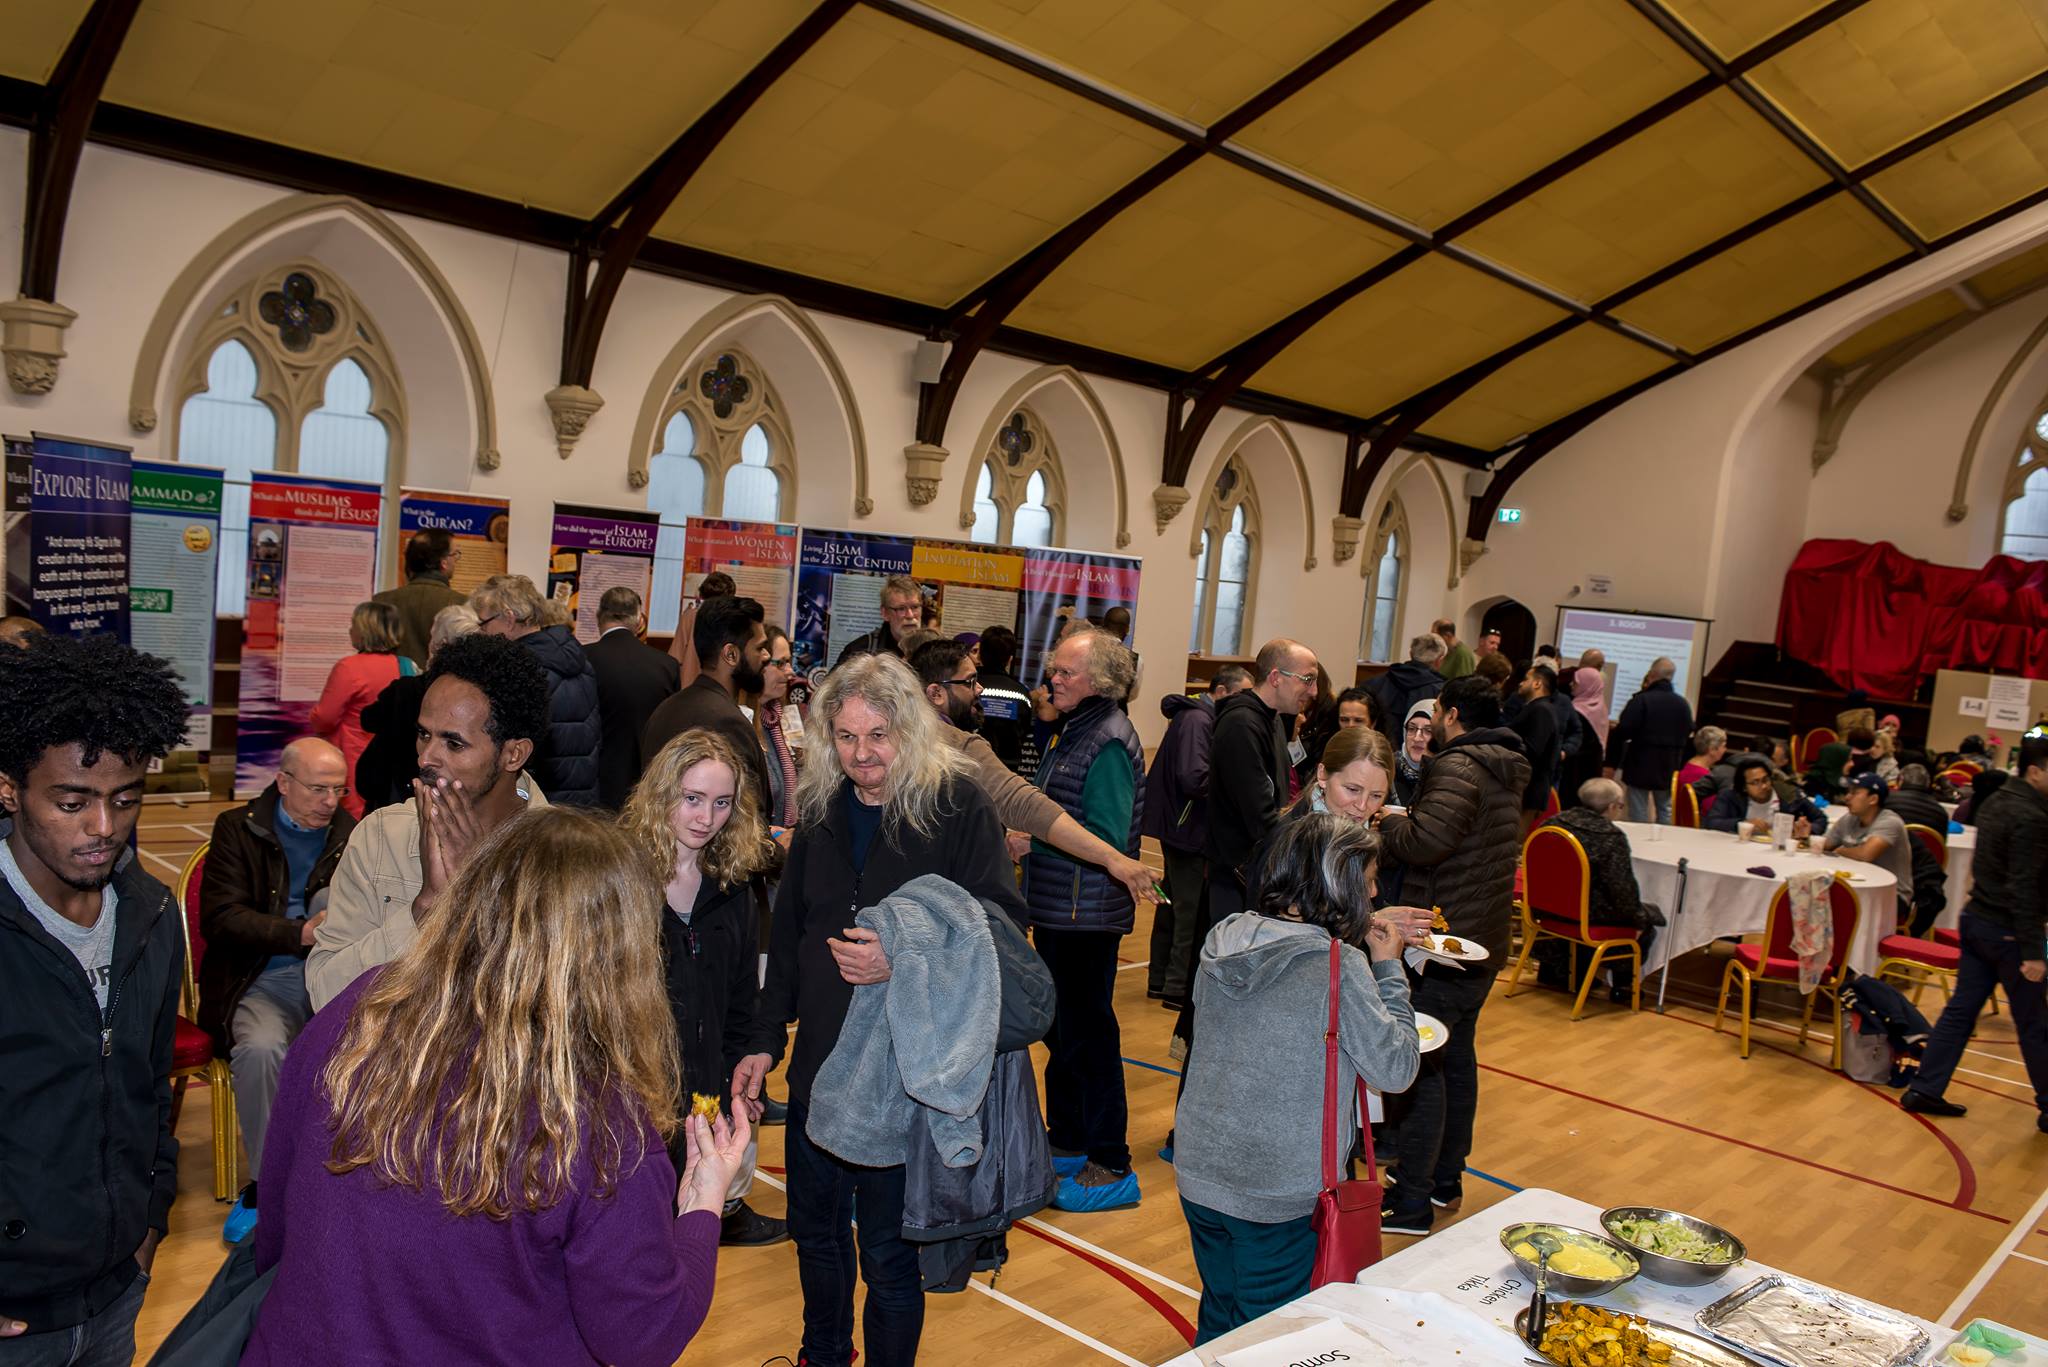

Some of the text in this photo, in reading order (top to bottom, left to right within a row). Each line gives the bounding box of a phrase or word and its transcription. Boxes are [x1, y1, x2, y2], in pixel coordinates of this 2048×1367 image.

[34, 469, 92, 499] EXPLORE
[95, 475, 129, 501] ISLAM
[285, 489, 352, 508] MUSLIMS
[334, 505, 378, 522] JESUS?
[554, 523, 569, 532] How
[614, 524, 647, 539] ISLAM
[605, 534, 654, 550] EUROPE?
[734, 535, 785, 550] WOMEN
[803, 541, 862, 556] Living ISLAM
[756, 544, 792, 561] ISLAM
[821, 553, 850, 566] 21ST
[853, 556, 912, 572] CENTURY
[1076, 568, 1114, 584] ISLAM
[1456, 1275, 1490, 1291] Tikka
[1480, 1279, 1522, 1305] Chicken
